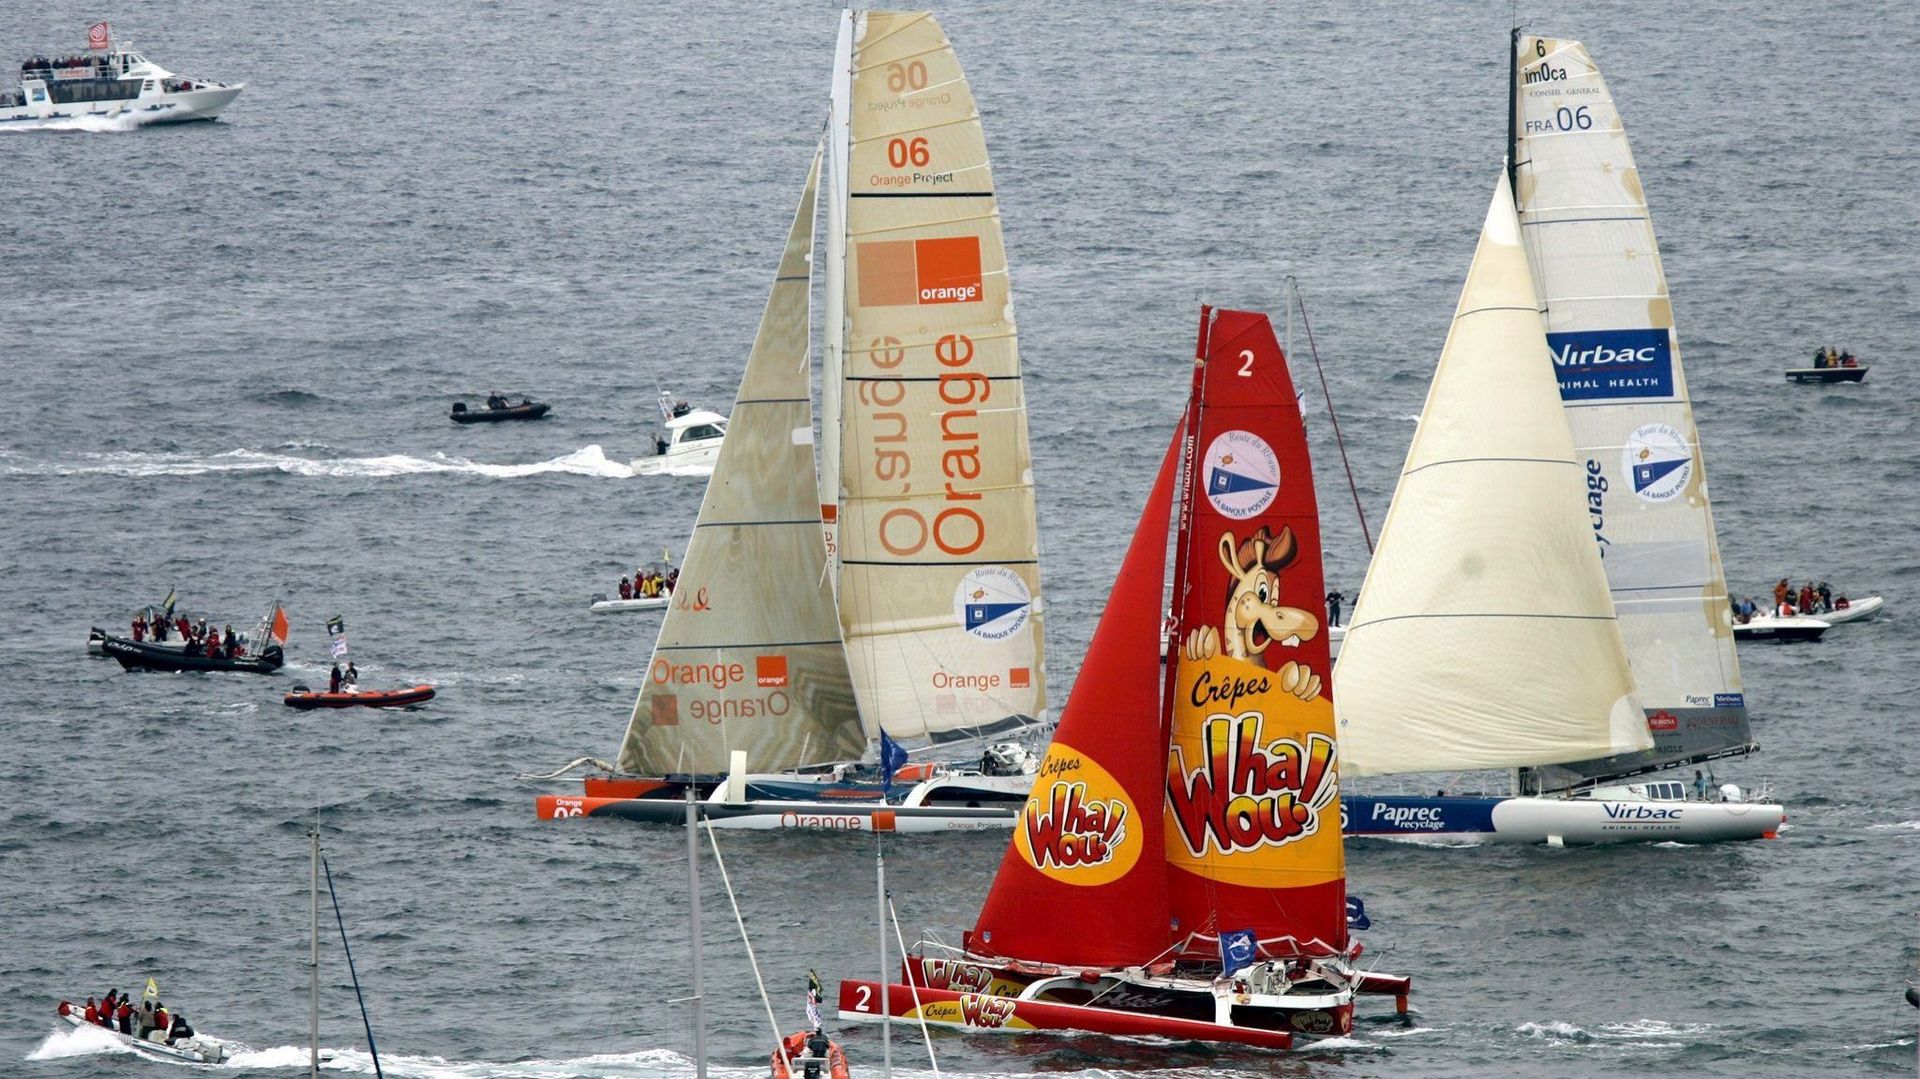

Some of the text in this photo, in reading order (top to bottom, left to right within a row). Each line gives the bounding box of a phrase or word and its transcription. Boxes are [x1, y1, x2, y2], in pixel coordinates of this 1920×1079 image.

[1536, 40, 1546, 57] 6
[1526, 119, 1554, 133] FRA
[1557, 106, 1592, 131] 06
[888, 137, 929, 168] 06
[871, 173, 954, 187] Orange Project
[1238, 350, 1254, 377] 2
[1559, 377, 1659, 390] NIMAL HEALTH
[933, 333, 990, 556] Orange
[1643, 465, 1691, 499] LA BANQUE POSTALE
[1213, 490, 1273, 516] LA BANQUE POSTALE
[982, 631, 1009, 640] BANQUE
[1009, 609, 1028, 633] POSTALE
[653, 659, 744, 690] Orange
[933, 672, 1000, 692] Orange
[1191, 671, 1272, 708] Crêpes
[1040, 754, 1081, 778] Crêpes
[556, 799, 582, 807] Orange
[1372, 802, 1442, 826] Paprec
[1602, 803, 1683, 820] Virbac
[1400, 820, 1445, 831] recyclage
[855, 985, 871, 1011] 2
[925, 1004, 957, 1018] Crêpes
